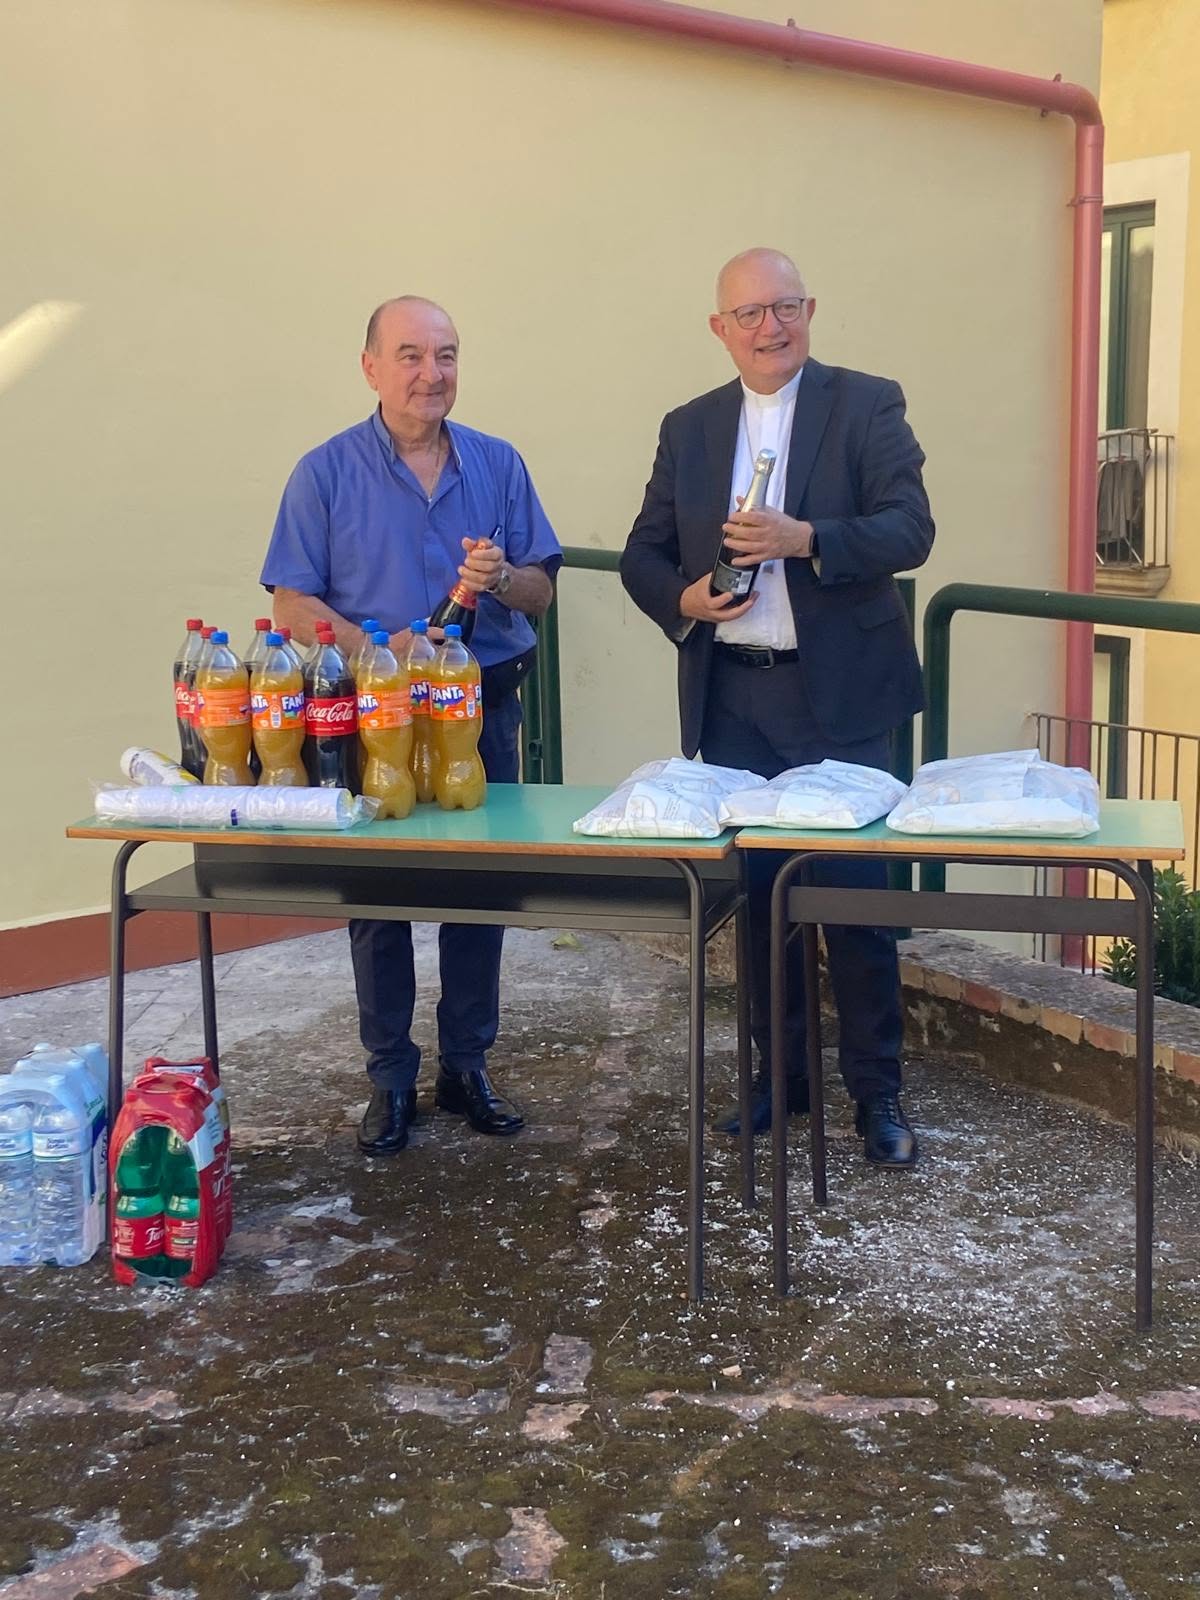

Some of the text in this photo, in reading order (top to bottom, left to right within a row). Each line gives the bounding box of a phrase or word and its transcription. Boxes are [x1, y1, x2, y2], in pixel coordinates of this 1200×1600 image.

[281, 690, 305, 710] FAN
[431, 686, 465, 701] FANTA
[250, 694, 269, 709] NTA
[358, 695, 378, 709] NTA
[306, 702, 353, 722] Coca-Cola
